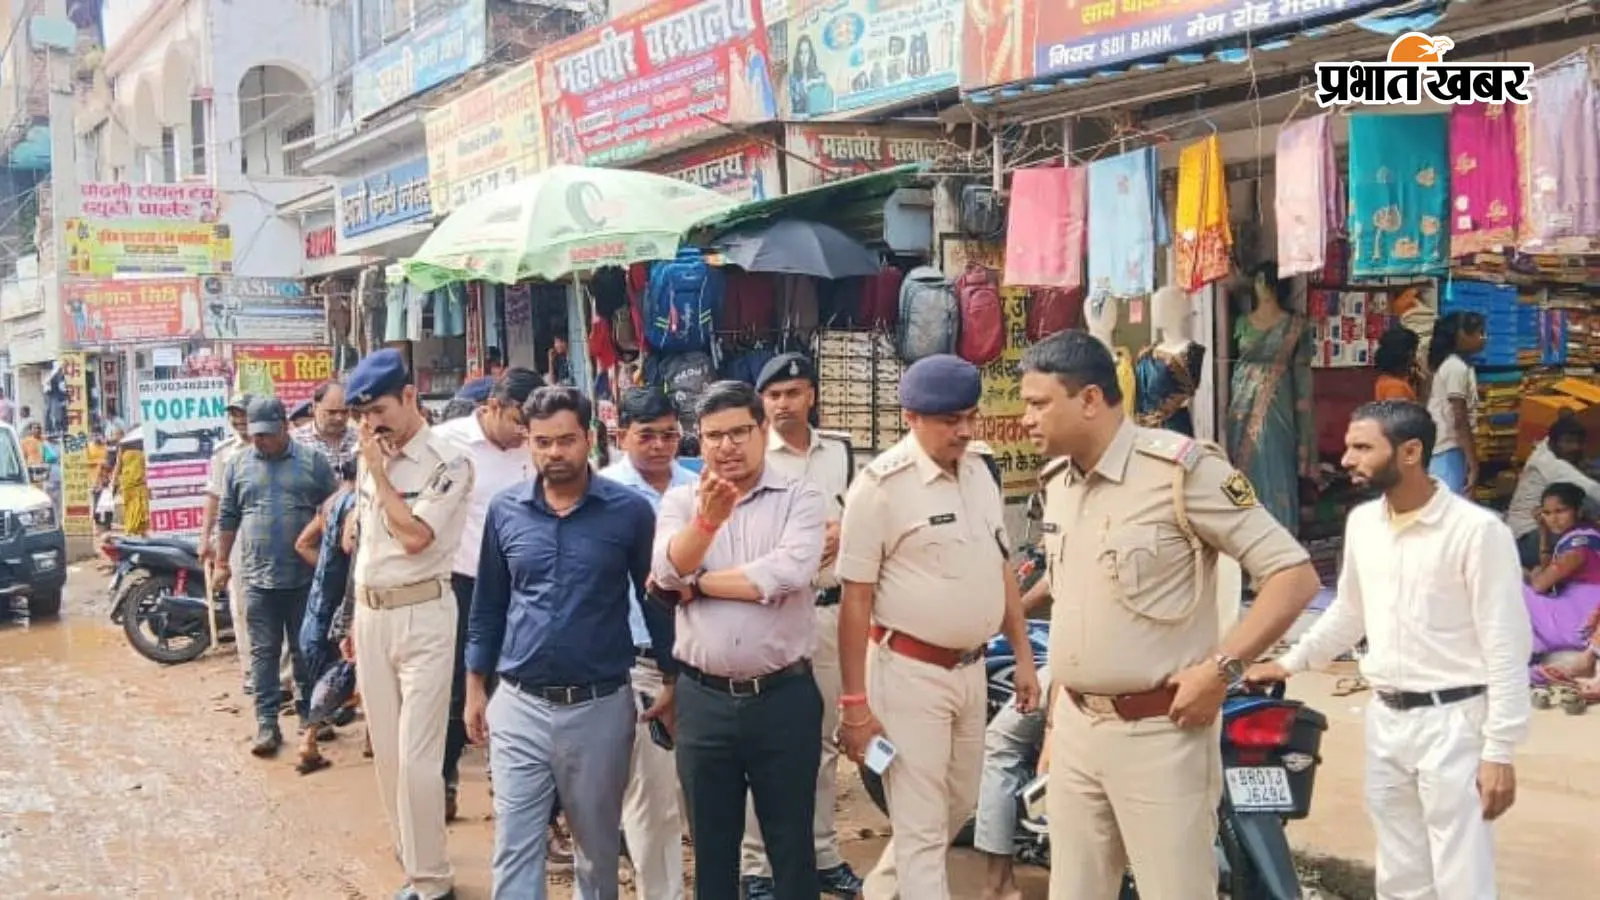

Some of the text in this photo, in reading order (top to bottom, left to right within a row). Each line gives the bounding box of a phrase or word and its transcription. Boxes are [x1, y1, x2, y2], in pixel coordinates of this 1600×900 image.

[1101, 34, 1125, 57] SBI
[554, 26, 638, 93] महावीर
[140, 396, 225, 421] TOOFAN
